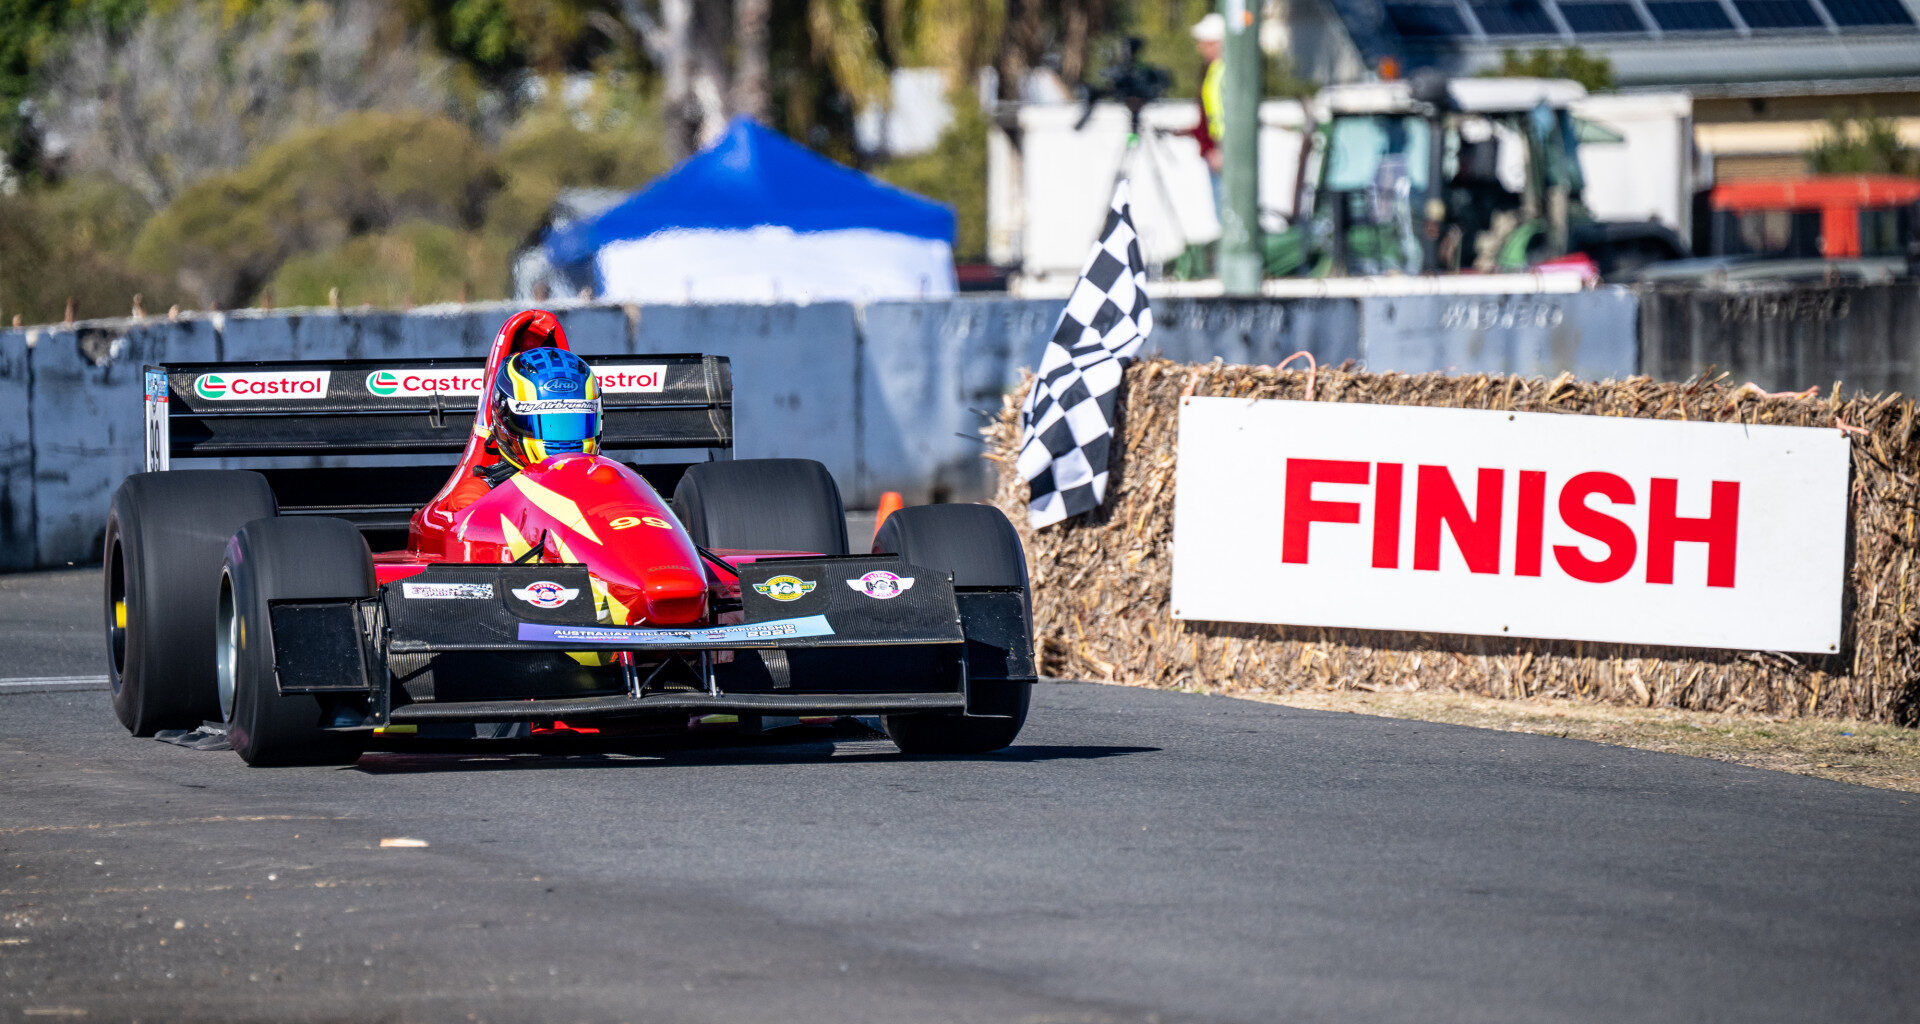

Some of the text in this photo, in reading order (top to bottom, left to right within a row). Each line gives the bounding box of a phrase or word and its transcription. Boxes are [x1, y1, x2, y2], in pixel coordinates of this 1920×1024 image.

[231, 377, 321, 395] Castrol
[402, 375, 482, 392] Castro
[549, 378, 574, 389] Arai
[596, 371, 657, 387] astrol
[609, 516, 673, 530] 99
[1281, 457, 1741, 588] FINISH
[553, 629, 632, 637] AUSTRALIAN
[699, 623, 795, 635] CHAMPIONSHIP
